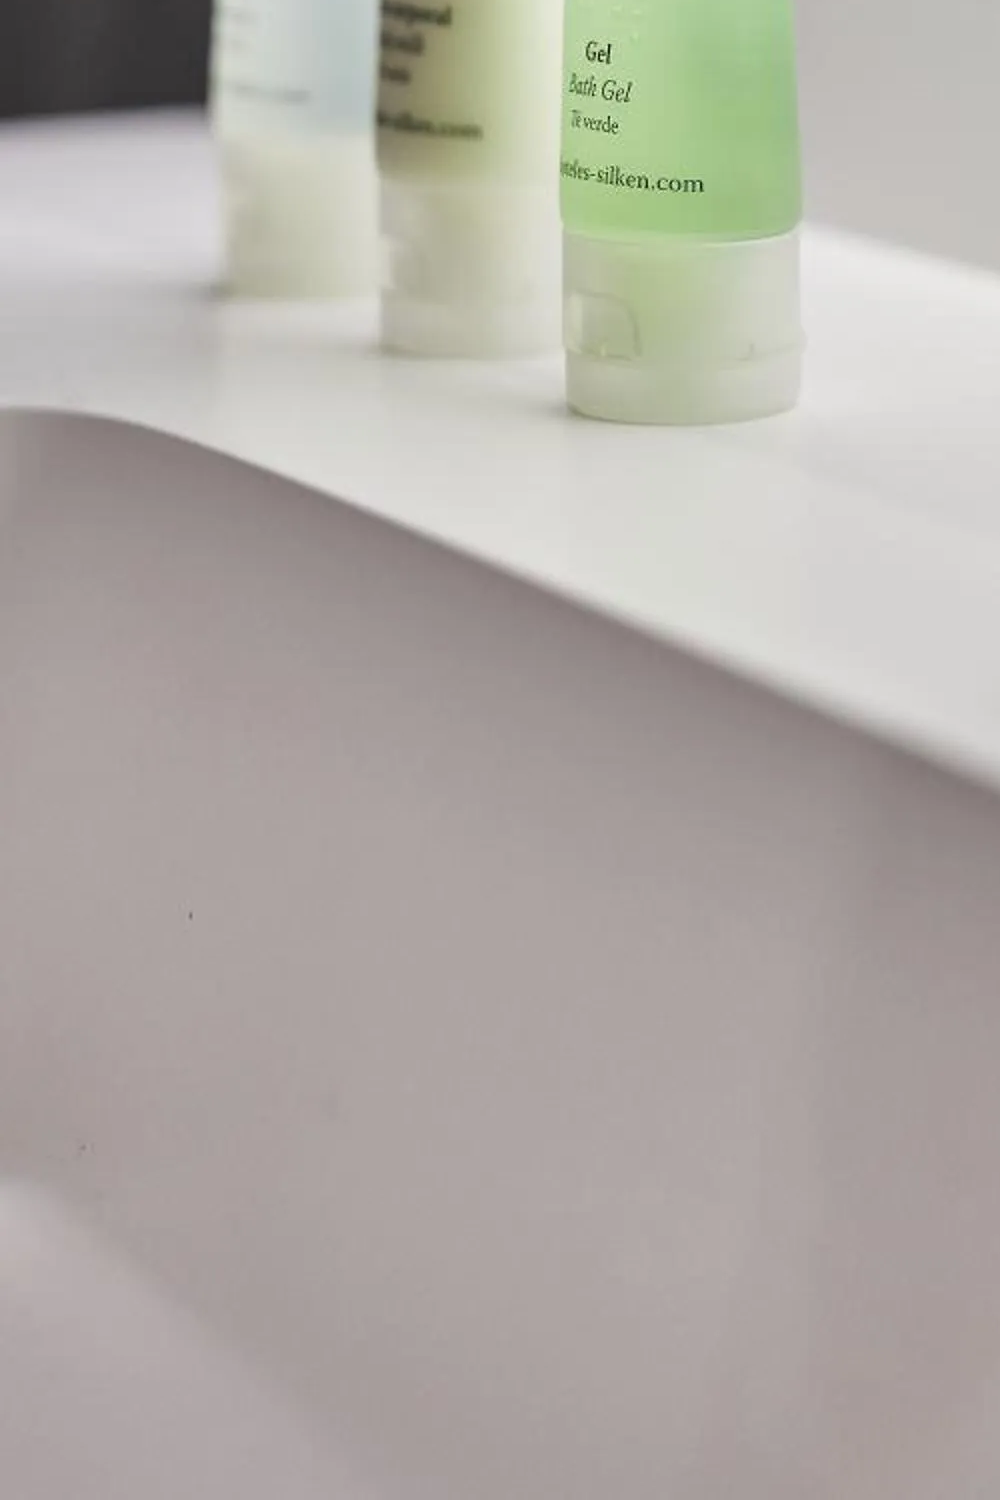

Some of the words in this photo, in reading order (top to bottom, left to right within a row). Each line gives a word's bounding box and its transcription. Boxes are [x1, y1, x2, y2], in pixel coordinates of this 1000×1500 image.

[585, 40, 612, 65] Gel
[568, 72, 597, 97] Bath
[601, 79, 633, 103] Gel
[583, 115, 619, 135] verde
